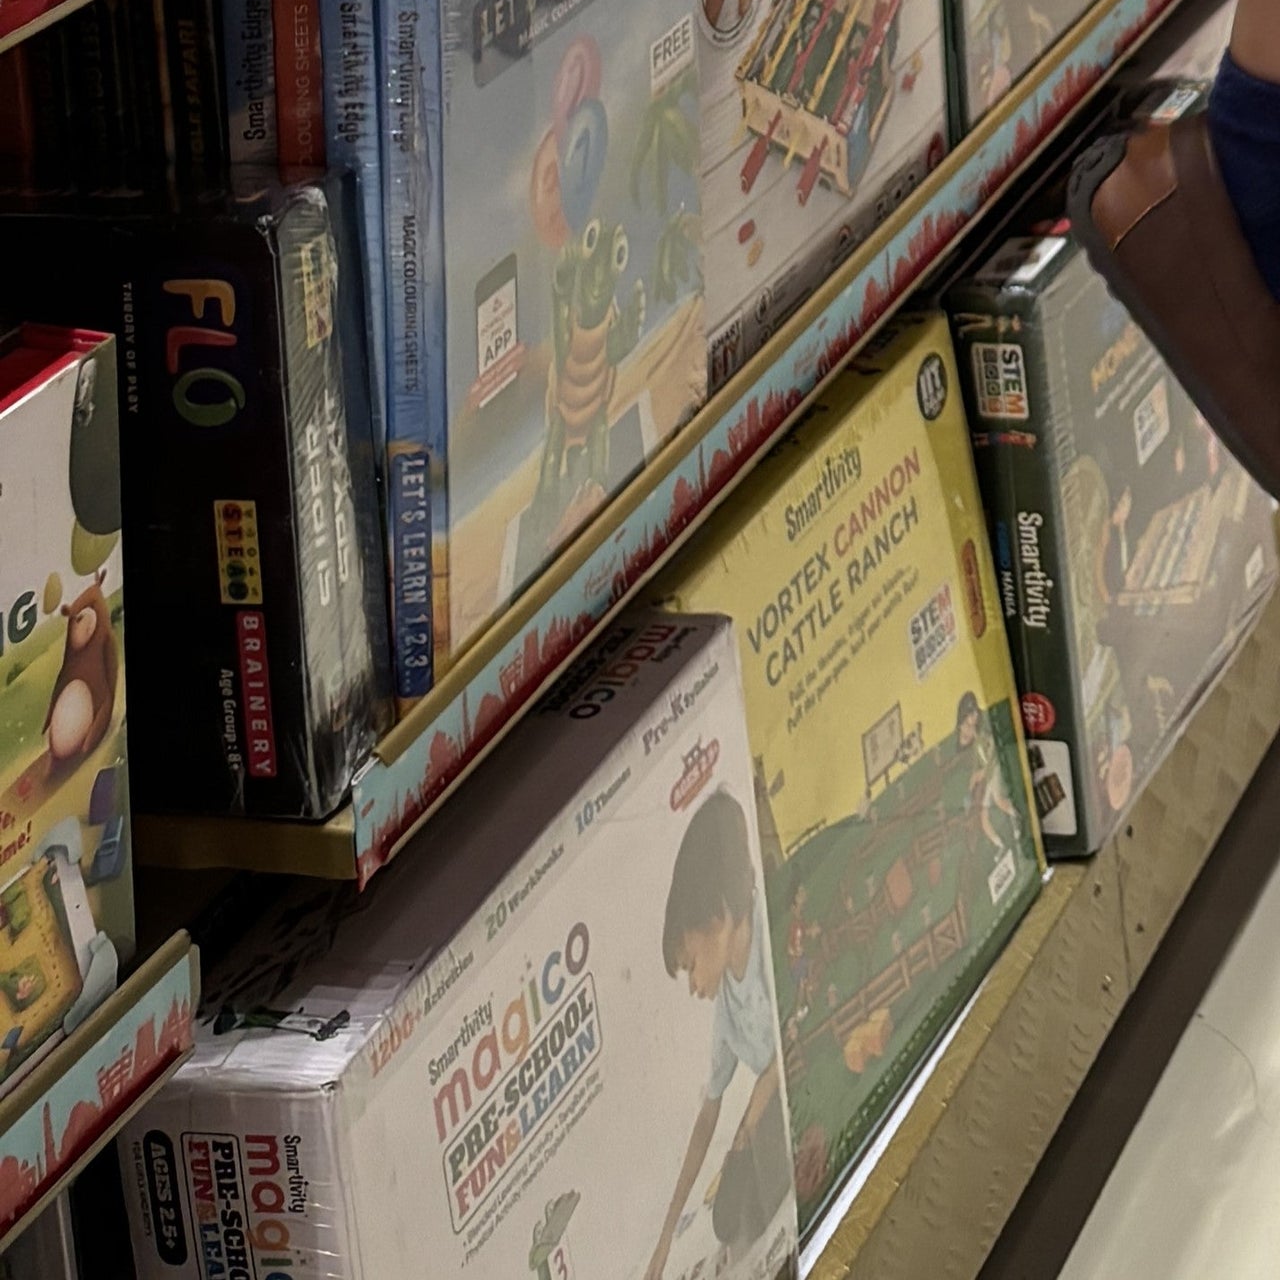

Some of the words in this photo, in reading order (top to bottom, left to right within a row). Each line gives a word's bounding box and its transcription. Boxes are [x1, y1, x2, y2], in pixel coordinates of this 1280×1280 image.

[650, 17, 692, 68] FREE
[162, 278, 247, 428] FLO
[1001, 346, 1026, 417] STEM
[400, 453, 429, 524] LET'S
[783, 445, 863, 543] Smartivity
[400, 530, 428, 605] LEARN
[745, 542, 831, 656] VORTEX
[832, 447, 922, 559] CANNON
[764, 578, 843, 688] CATTLE
[847, 496, 920, 597] RANCH
[1016, 511, 1049, 629] Smartivity
[240, 613, 274, 775] BRAINERY
[427, 994, 494, 1087] Smartivity
[432, 922, 591, 1144] magico
[447, 986, 595, 1186] PRE-SCHOOL
[283, 1134, 309, 1214] Smartivity
